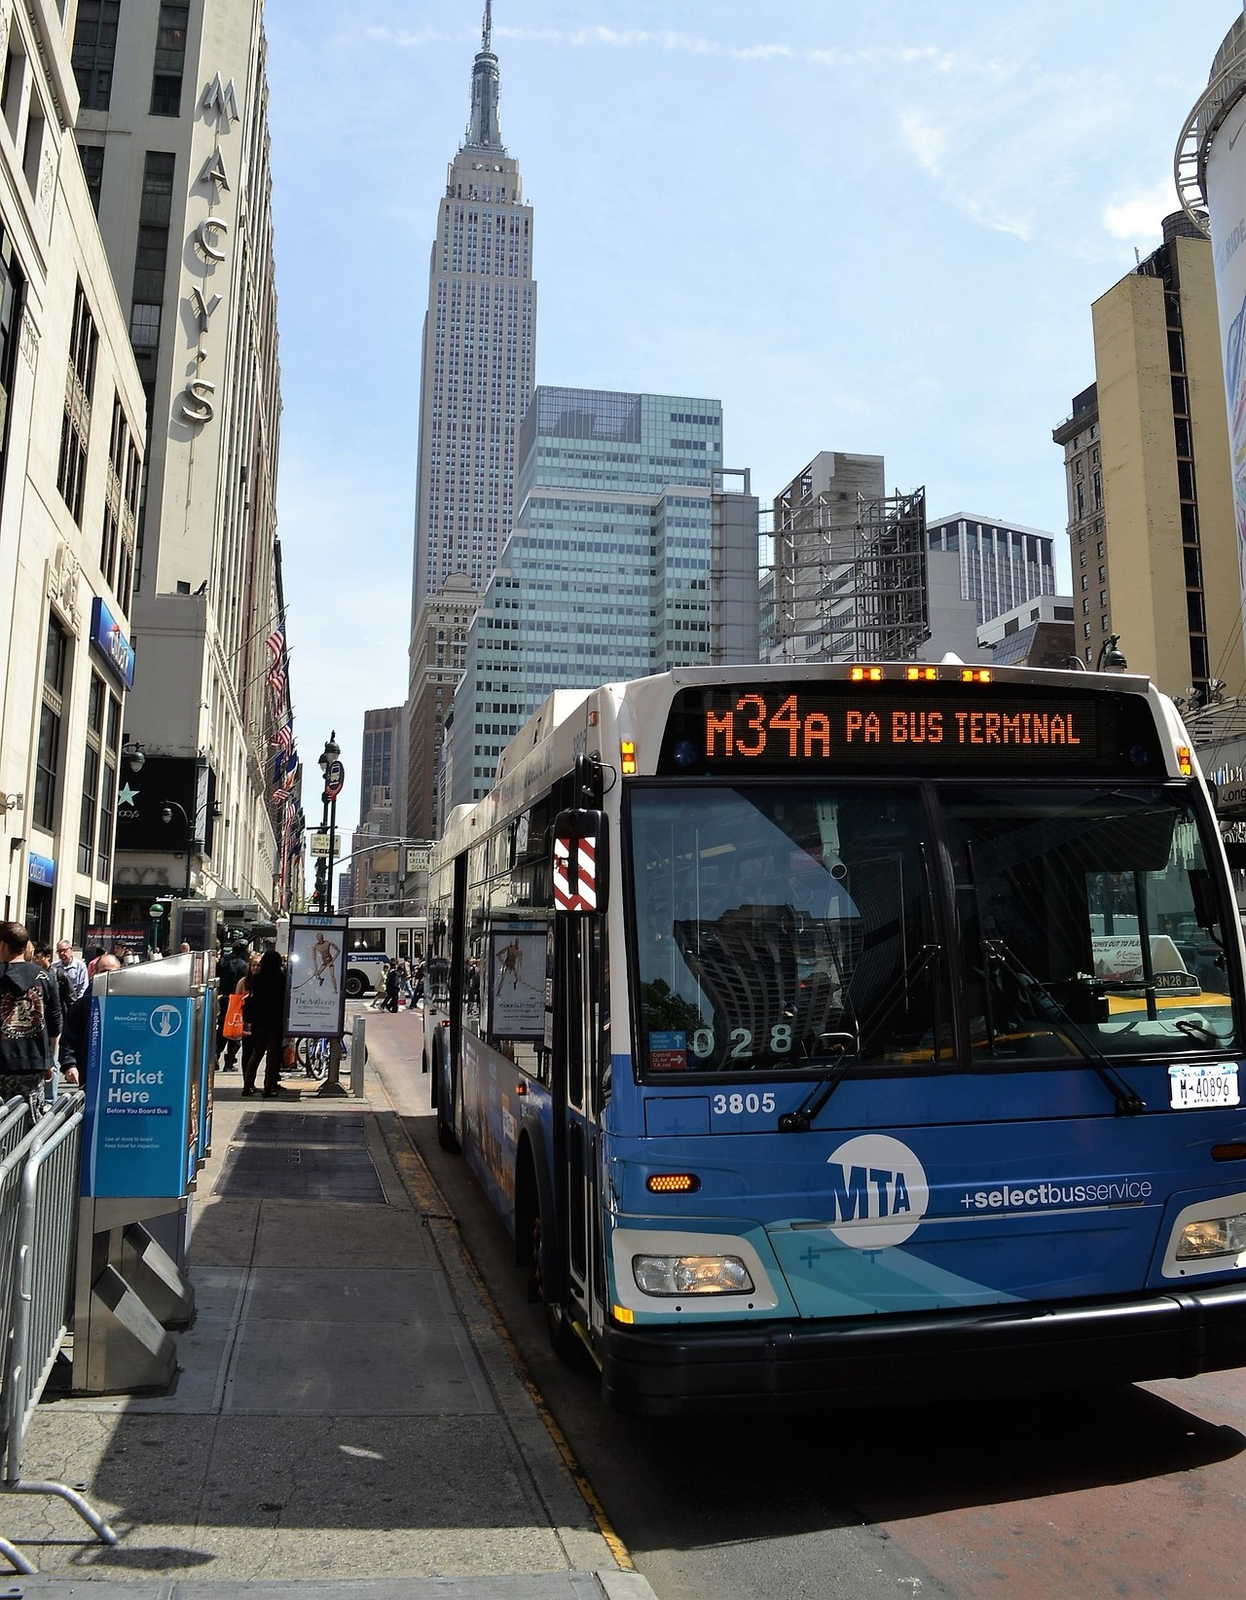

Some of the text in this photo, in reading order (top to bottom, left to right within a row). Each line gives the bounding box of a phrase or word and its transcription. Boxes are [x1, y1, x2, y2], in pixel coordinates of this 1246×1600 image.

[182, 71, 240, 423] MACY'S
[706, 694, 1081, 757] M34A PA BUS TERMINAL
[306, 916, 333, 925] TITAN
[1156, 975, 1182, 987] 3N28
[110, 1049, 142, 1065] Get
[109, 1069, 164, 1084] Ticket
[107, 1088, 150, 1103] Here
[713, 1093, 776, 1115] 3805
[832, 1164, 911, 1223] MTA
